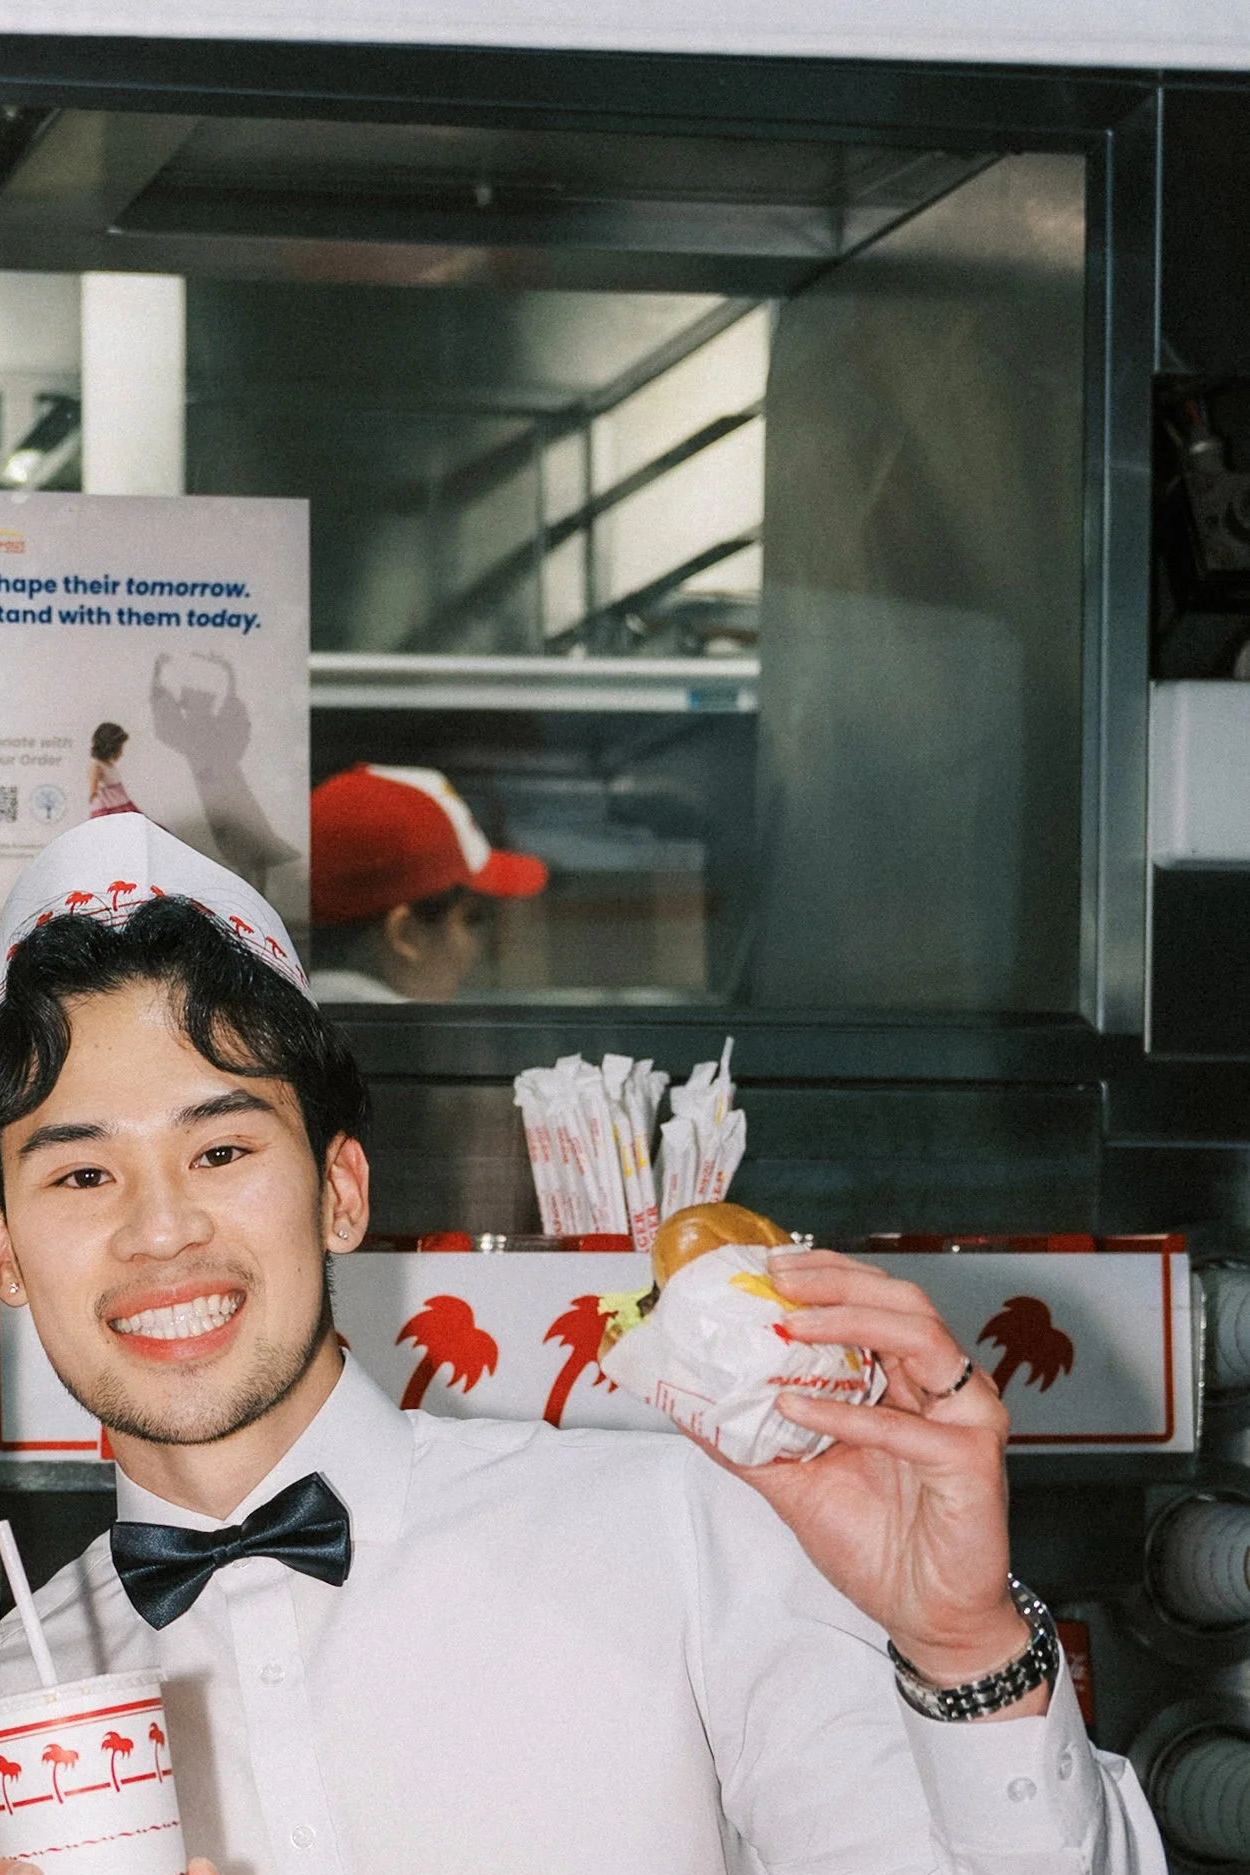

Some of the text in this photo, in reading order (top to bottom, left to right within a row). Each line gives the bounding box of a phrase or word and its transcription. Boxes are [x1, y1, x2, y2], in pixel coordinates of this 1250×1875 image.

[63, 574, 120, 595] their
[126, 577, 250, 598] tomorrow.
[58, 604, 111, 625] with
[117, 607, 180, 627] them
[187, 608, 261, 635] today.
